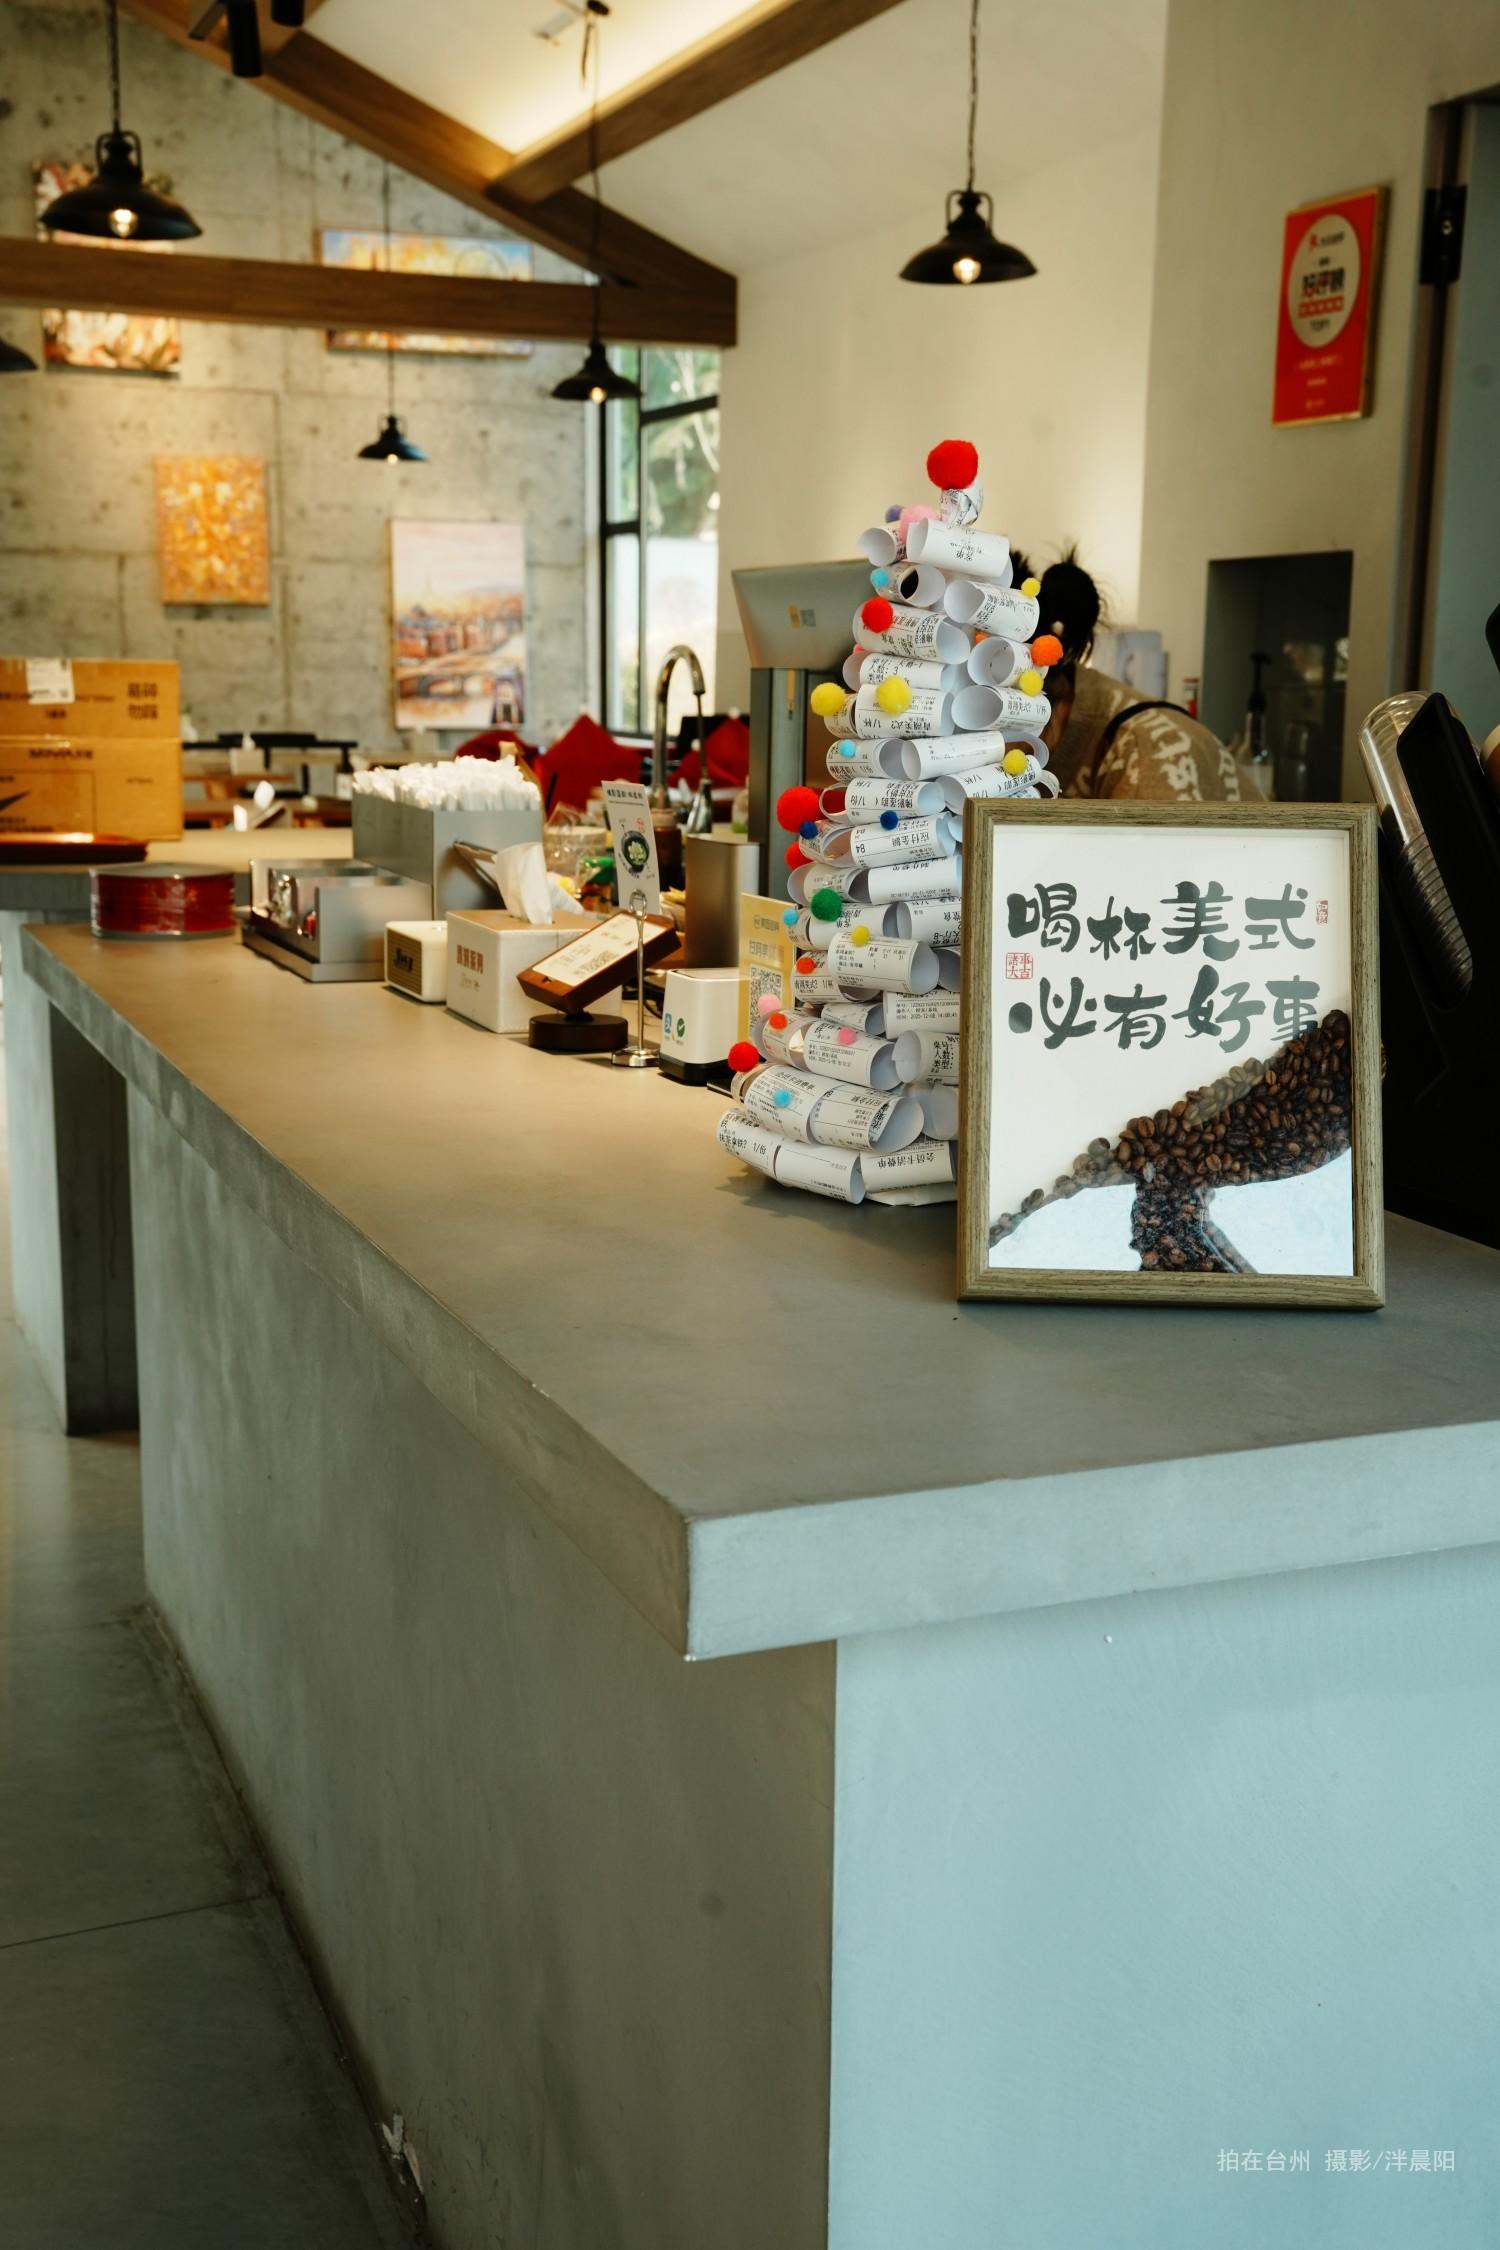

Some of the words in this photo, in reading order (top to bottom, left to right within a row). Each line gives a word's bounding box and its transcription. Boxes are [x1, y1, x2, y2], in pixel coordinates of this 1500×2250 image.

[1006, 881, 1316, 961] 喝杯美式
[1008, 964, 1321, 1053] 必有好事
[877, 1152, 935, 1168] 会员卡消费单
